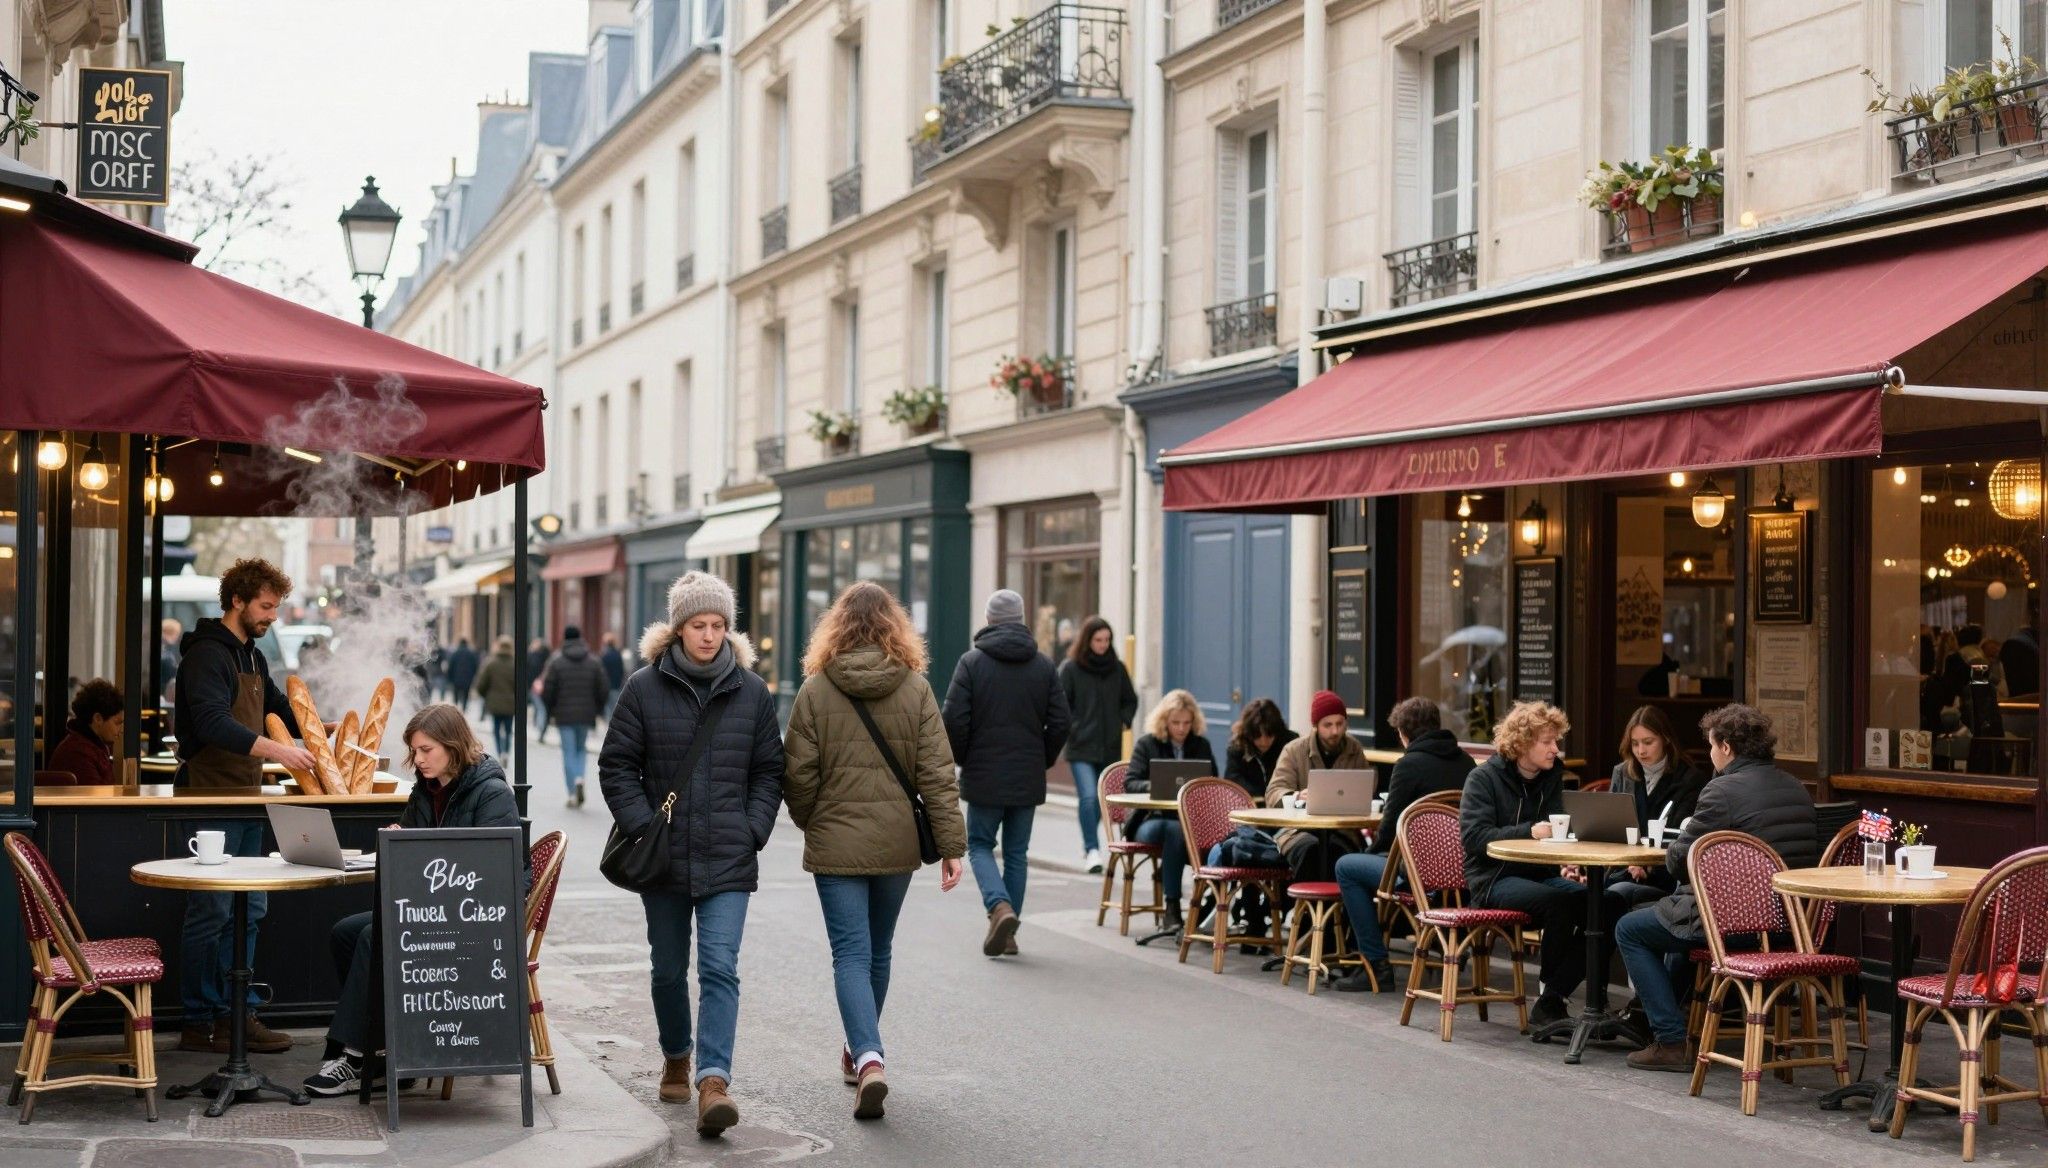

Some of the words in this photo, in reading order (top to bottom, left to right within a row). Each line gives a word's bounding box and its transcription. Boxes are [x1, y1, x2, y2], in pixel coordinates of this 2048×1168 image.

[90, 161, 155, 189] ORFF
[1493, 443, 1507, 469] E
[491, 958, 507, 980] &
